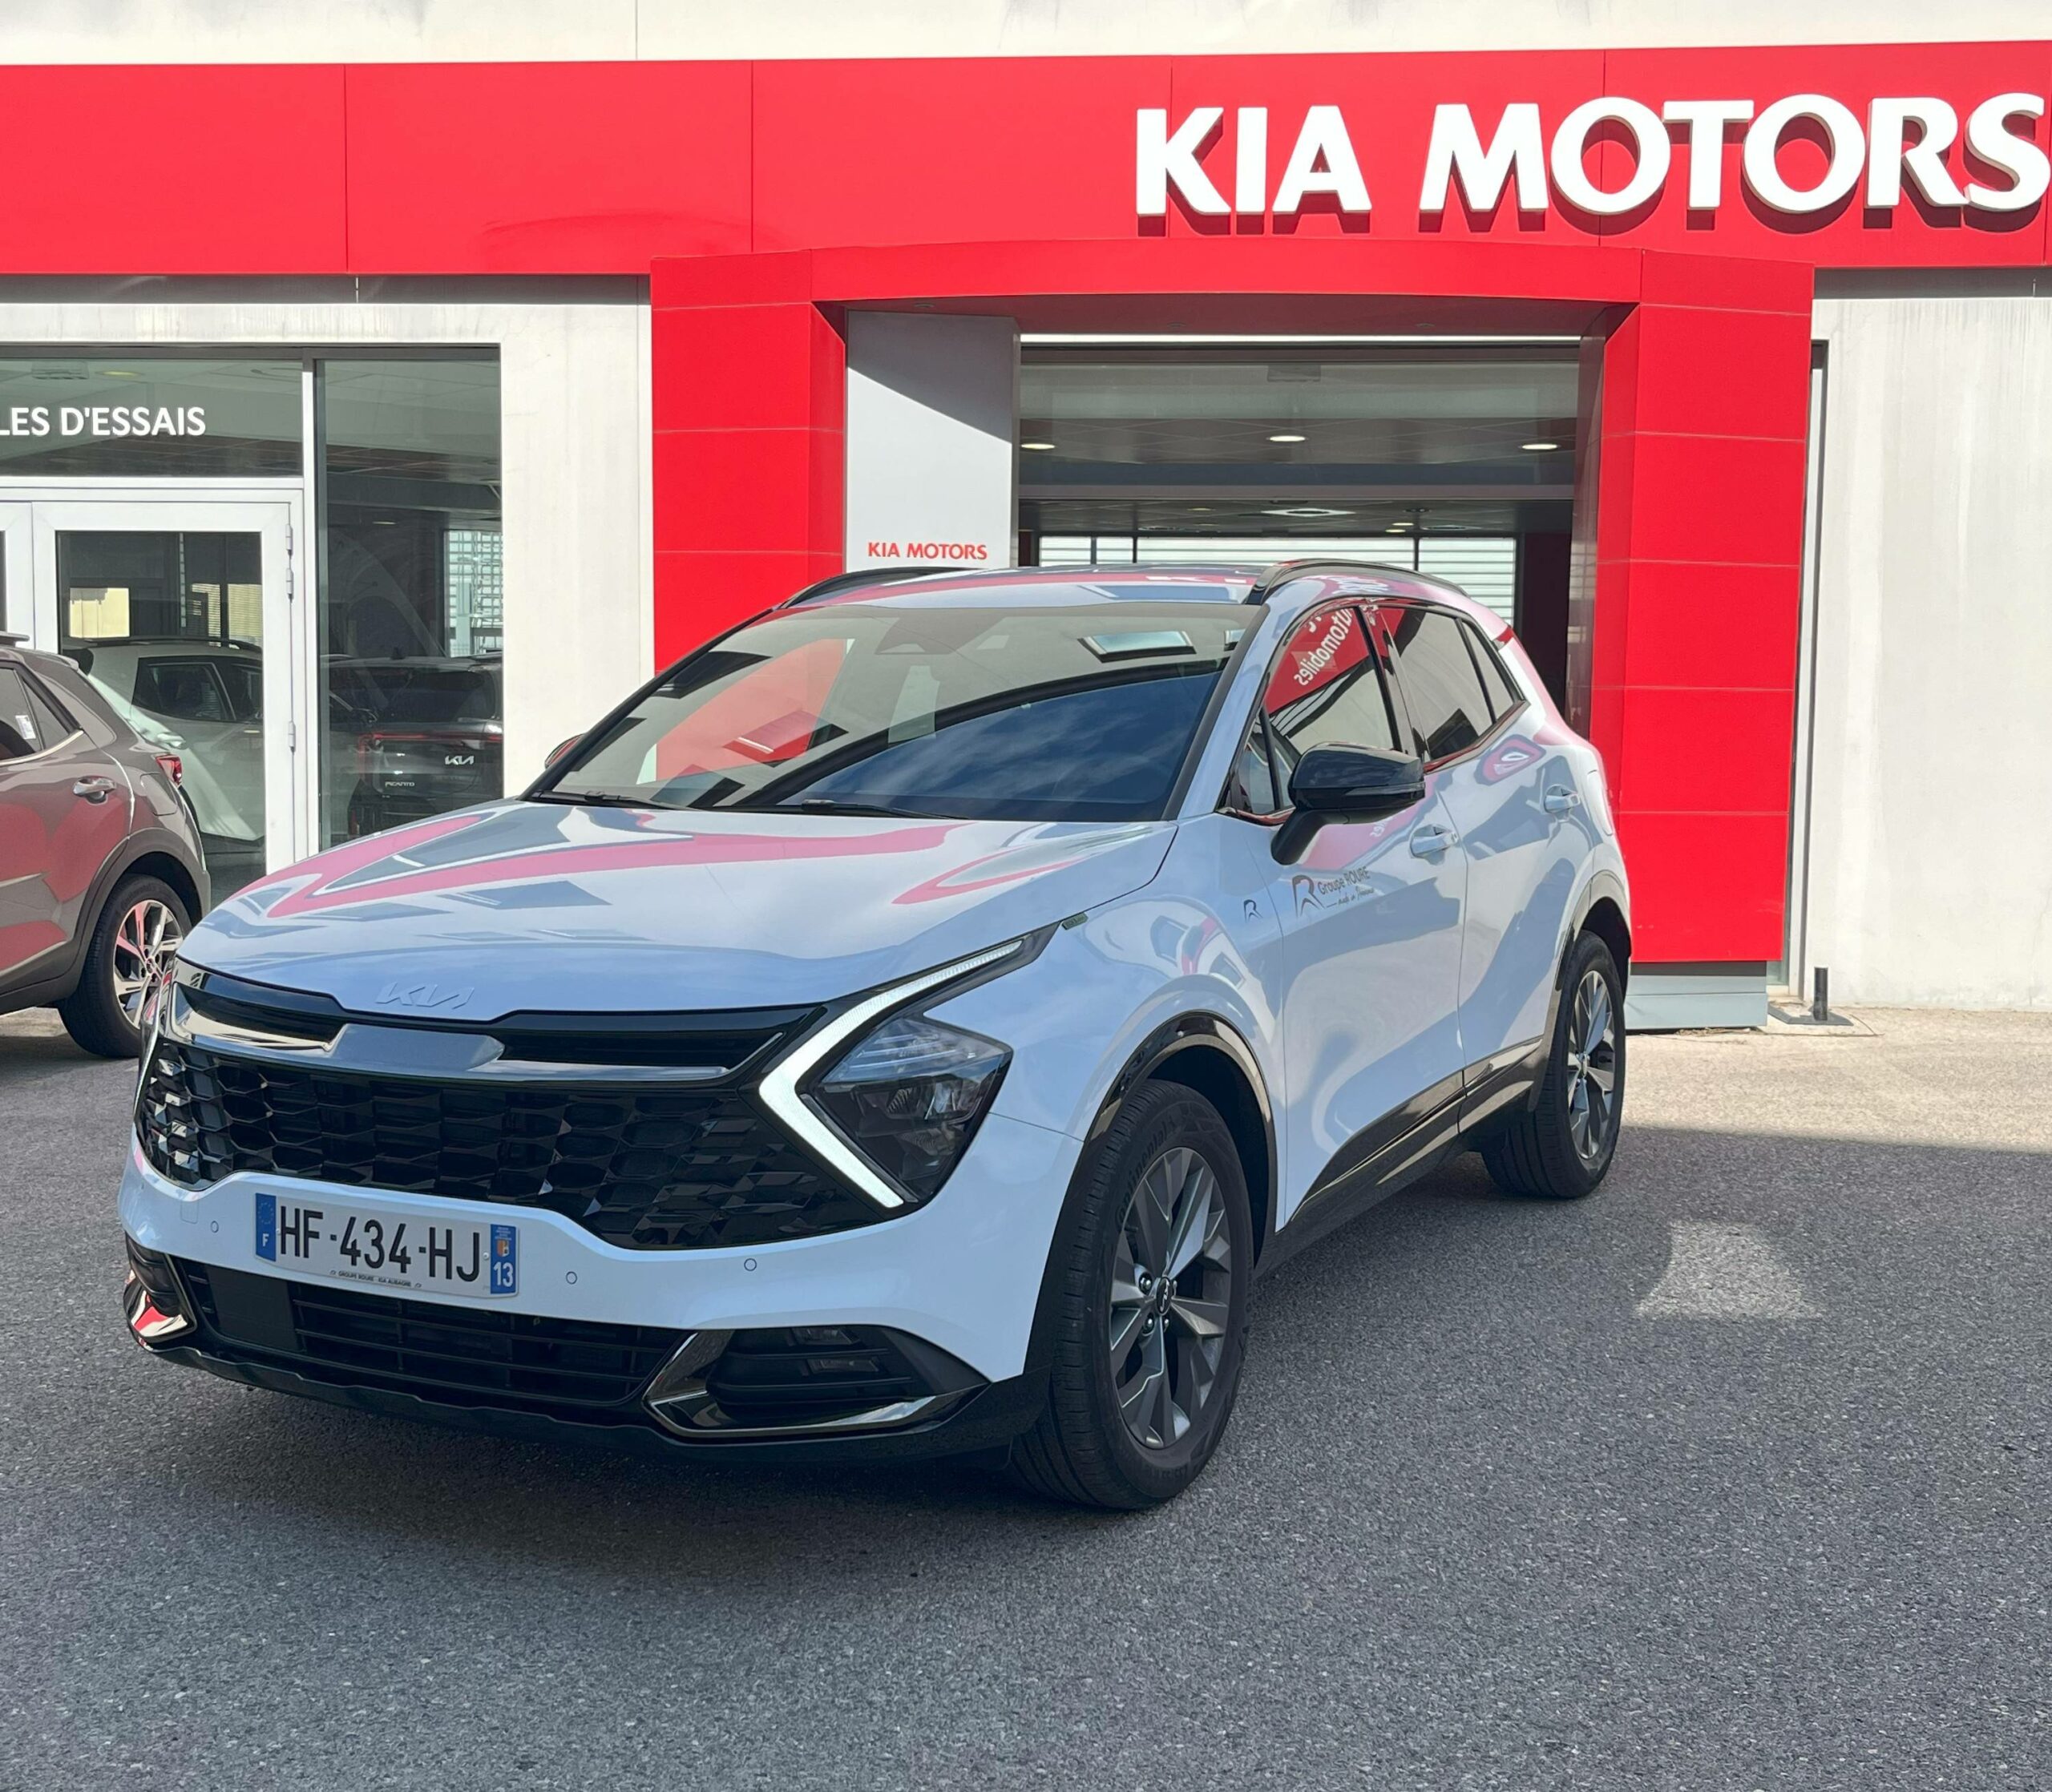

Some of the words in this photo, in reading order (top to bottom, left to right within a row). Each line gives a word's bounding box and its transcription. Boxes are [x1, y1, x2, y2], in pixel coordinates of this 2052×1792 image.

[1137, 105, 1372, 215] KIA
[1419, 92, 2050, 215] MOTORS
[0, 407, 50, 437] ES
[60, 406, 206, 437] D'ESSAIS
[868, 542, 900, 558] KIA
[907, 543, 988, 560] MOTORS
[445, 756, 475, 765] KIA
[1318, 878, 1345, 895] Groupe
[376, 981, 475, 1010] KIA
[262, 1233, 269, 1248] F
[281, 1205, 480, 1282] HF-434-HJ
[493, 1261, 514, 1288] 13
